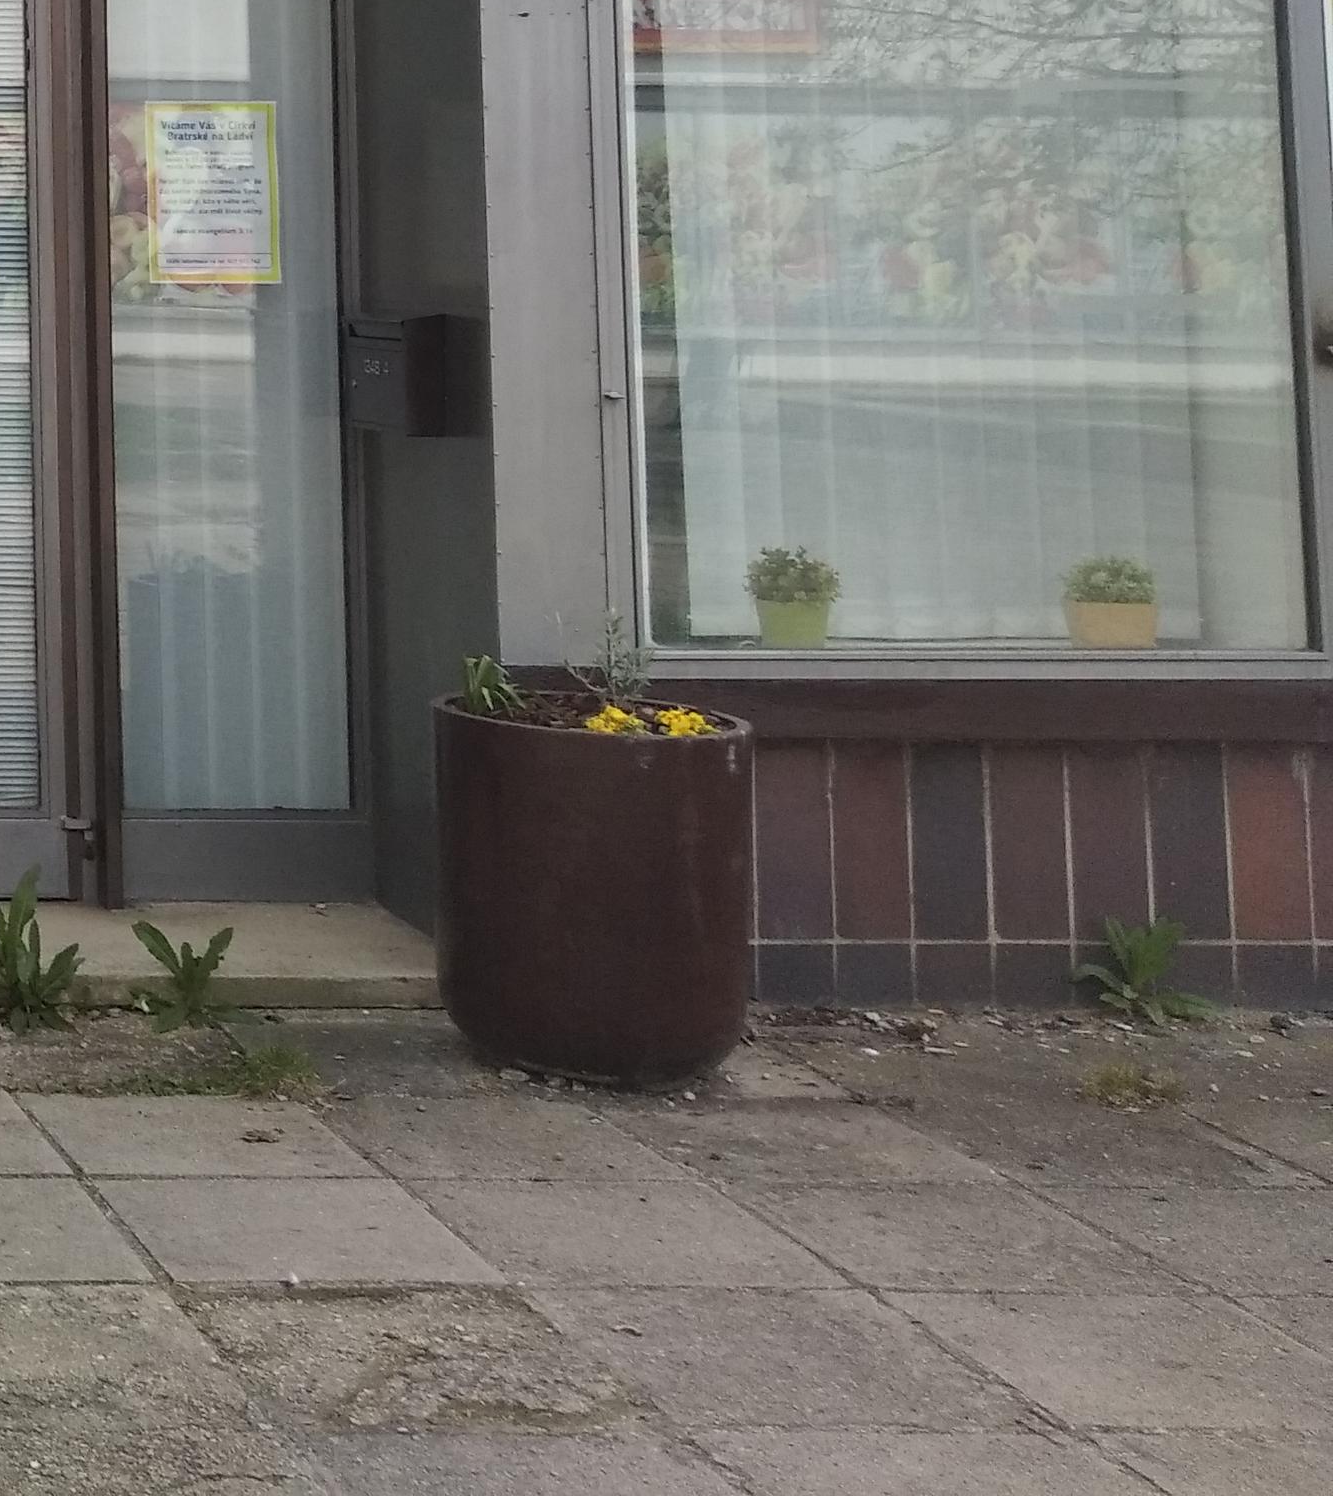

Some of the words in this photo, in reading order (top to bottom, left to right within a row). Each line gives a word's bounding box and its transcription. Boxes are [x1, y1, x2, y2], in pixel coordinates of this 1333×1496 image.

[198, 120, 216, 130] Vás
[167, 131, 208, 141] Bratrské
[211, 133, 224, 141] na
